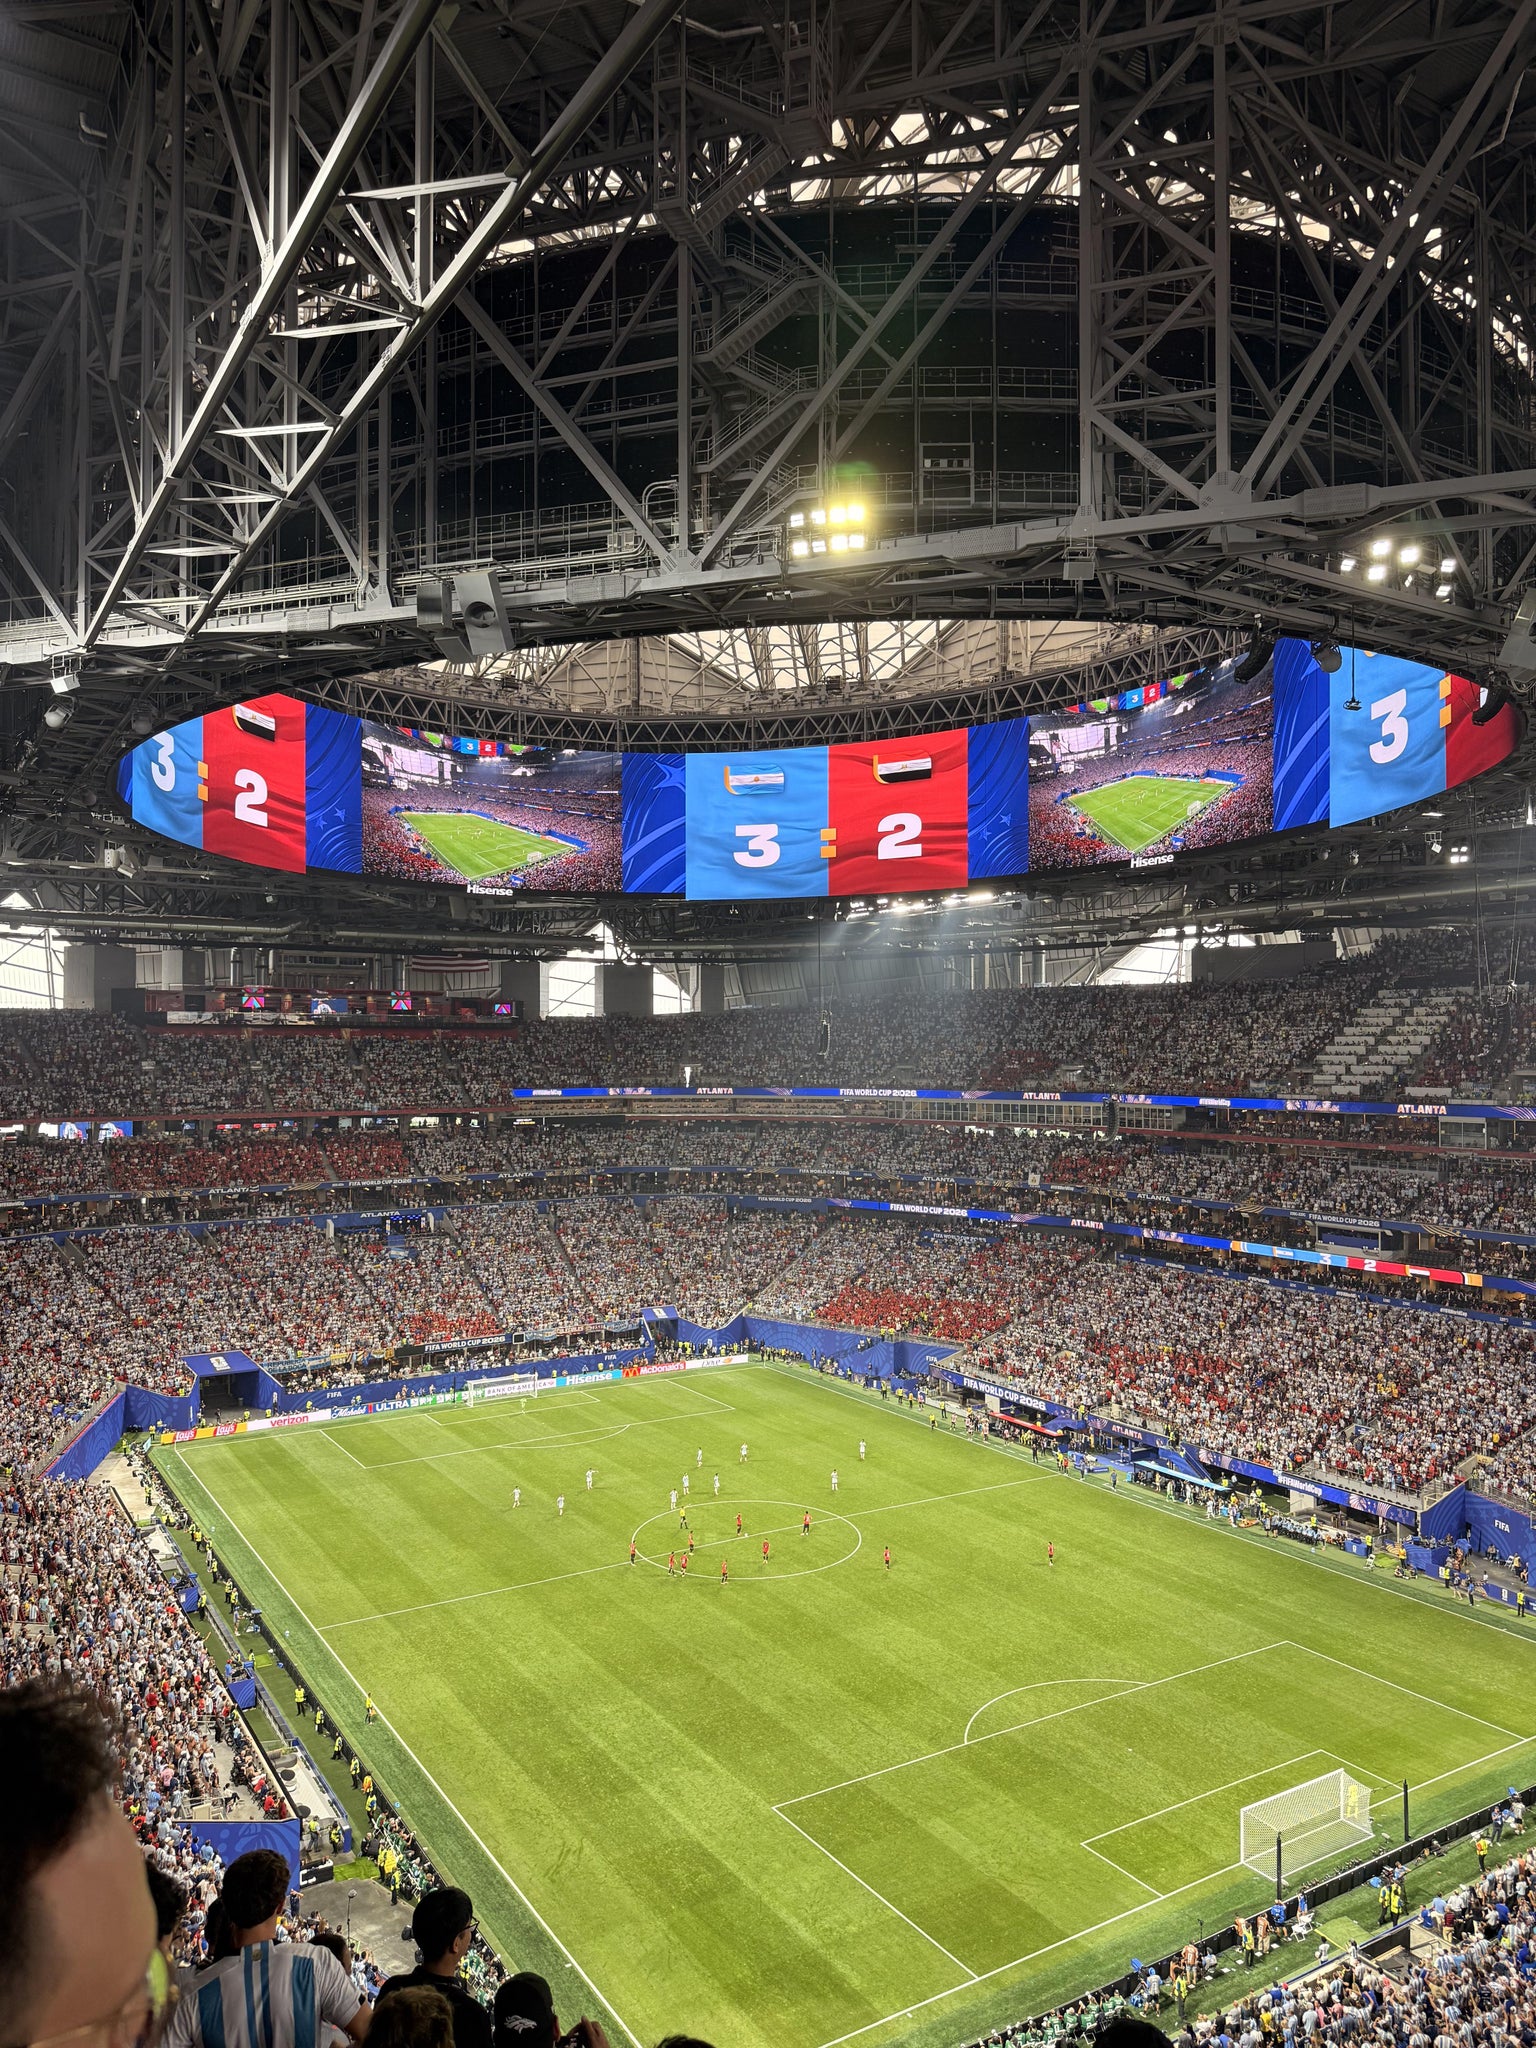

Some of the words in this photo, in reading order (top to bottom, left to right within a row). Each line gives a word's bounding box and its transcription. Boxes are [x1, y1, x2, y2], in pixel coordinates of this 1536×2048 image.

[1132, 694, 1139, 703] 3
[1369, 688, 1409, 764] 3
[150, 731, 175, 792] 3
[234, 769, 269, 827] 2
[733, 823, 781, 868] 3
[877, 812, 923, 860] 2
[1130, 854, 1174, 869] Hisense
[466, 884, 514, 896] Hisense
[696, 1087, 734, 1095] ATLANTA
[840, 1088, 854, 1096] FIFA
[892, 1089, 918, 1097] 2026
[1022, 1092, 1061, 1100] ATLANTA
[1396, 1104, 1448, 1115] ATLANTA
[922, 1175, 956, 1183] ATLANTA
[1136, 1193, 1171, 1202] ATLANTA
[361, 1210, 401, 1218] ATLANTA
[890, 1203, 904, 1212] FIFA
[904, 1204, 929, 1214] WORLD
[928, 1206, 943, 1215] CUP
[943, 1207, 968, 1217] 2026
[1071, 1218, 1104, 1230] ATLANTA
[1308, 1213, 1322, 1221] FIFA
[1322, 1215, 1344, 1223] WORLD
[1344, 1217, 1358, 1225] CUP
[1358, 1219, 1380, 1227] 2026
[1320, 1253, 1332, 1265] 3
[1363, 1259, 1377, 1272] 2
[425, 1343, 441, 1352] FIFA
[441, 1340, 466, 1349] WORLD
[467, 1338, 481, 1347] CUP
[481, 1336, 505, 1345] 2026
[640, 1362, 685, 1375] McDonald's
[565, 1371, 613, 1386] Hisense
[327, 1391, 342, 1399] FIFA
[487, 1386, 506, 1395] BANK
[507, 1384, 516, 1392] OF
[964, 1378, 979, 1390] FIFA
[978, 1382, 1004, 1398] WORLD
[1004, 1388, 1019, 1401] CUP
[1019, 1395, 1046, 1411] 2026
[375, 1399, 410, 1412] ULTRA
[270, 1414, 309, 1427] verizon
[1112, 1425, 1143, 1440] ATLANTA
[1494, 1519, 1510, 1533] FIFA
